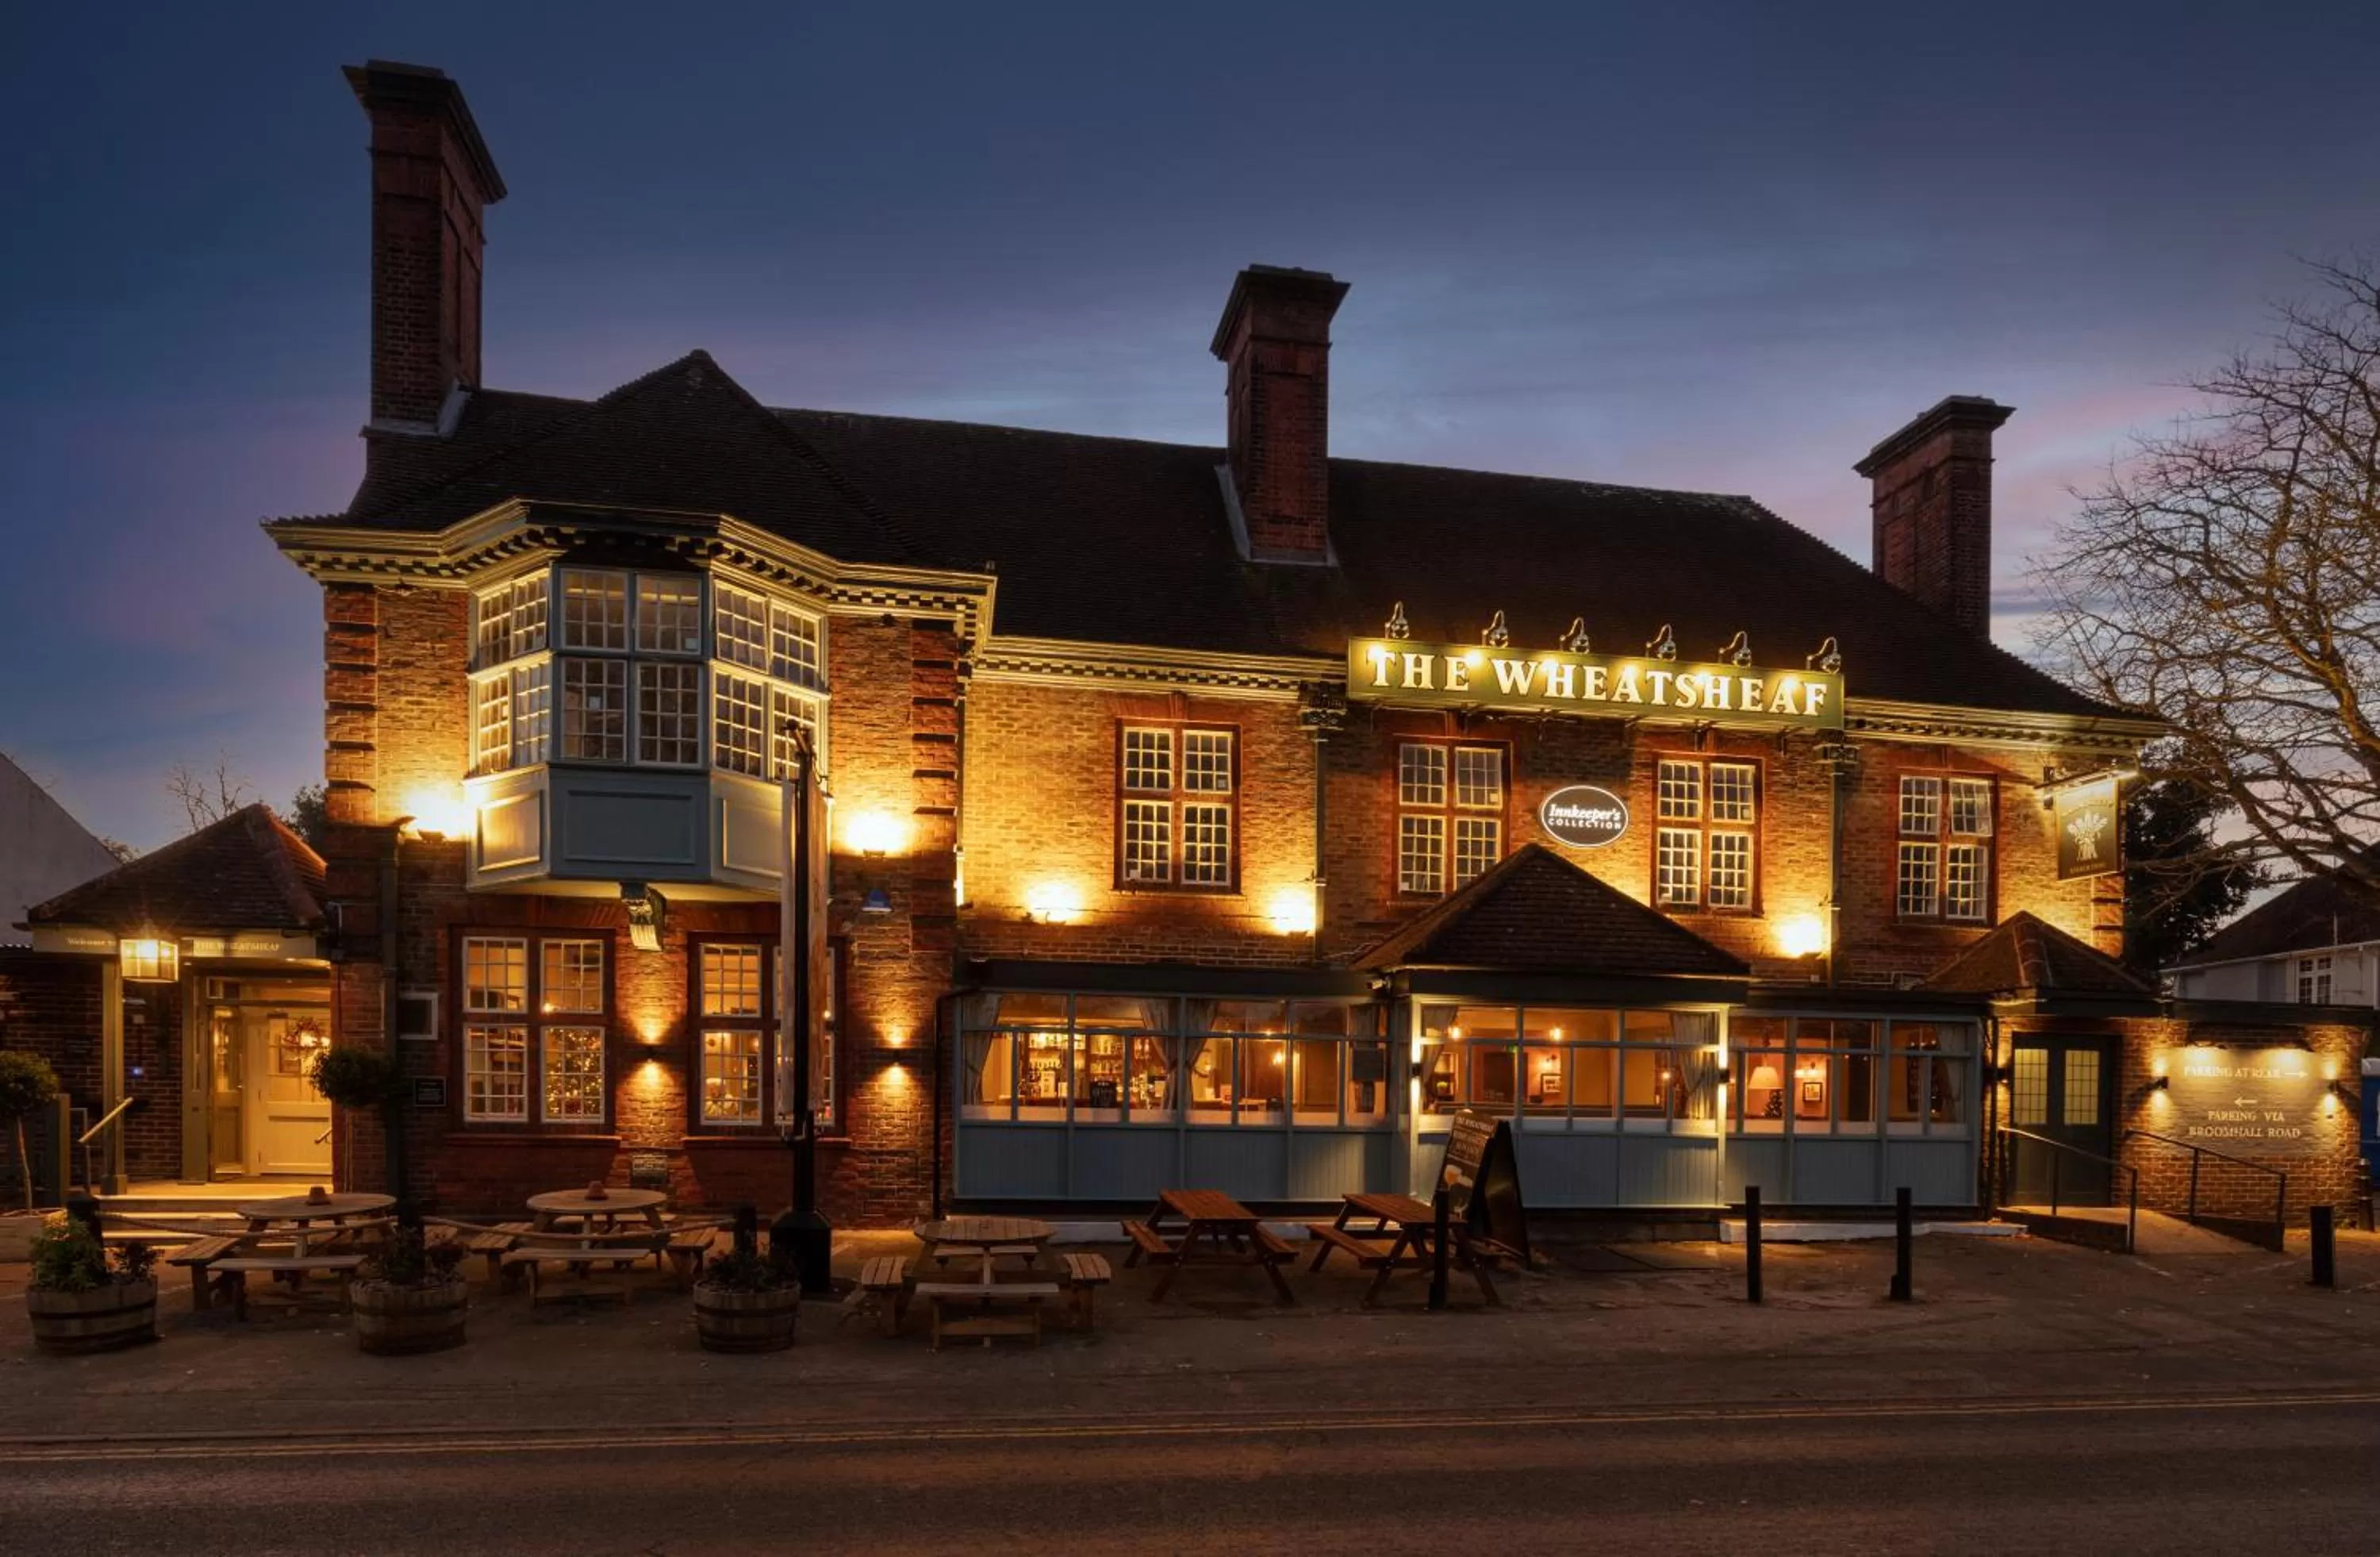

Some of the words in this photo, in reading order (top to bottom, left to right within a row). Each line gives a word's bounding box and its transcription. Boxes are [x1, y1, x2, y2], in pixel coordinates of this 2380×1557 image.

[1366, 648, 1470, 692] THE
[1491, 658, 1828, 717] WHEATSHEAF
[1548, 803, 1622, 822] Innkeeper's
[1548, 818, 1622, 829] COLLECTION
[2184, 1066, 2232, 1078] PARKING
[2235, 1067, 2249, 1078] AT
[2207, 1110, 2257, 1121] PARKING
[2264, 1112, 2286, 1122] VIA
[2188, 1126, 2262, 1137] BROOMHALL
[2267, 1128, 2301, 1138] ROAD
